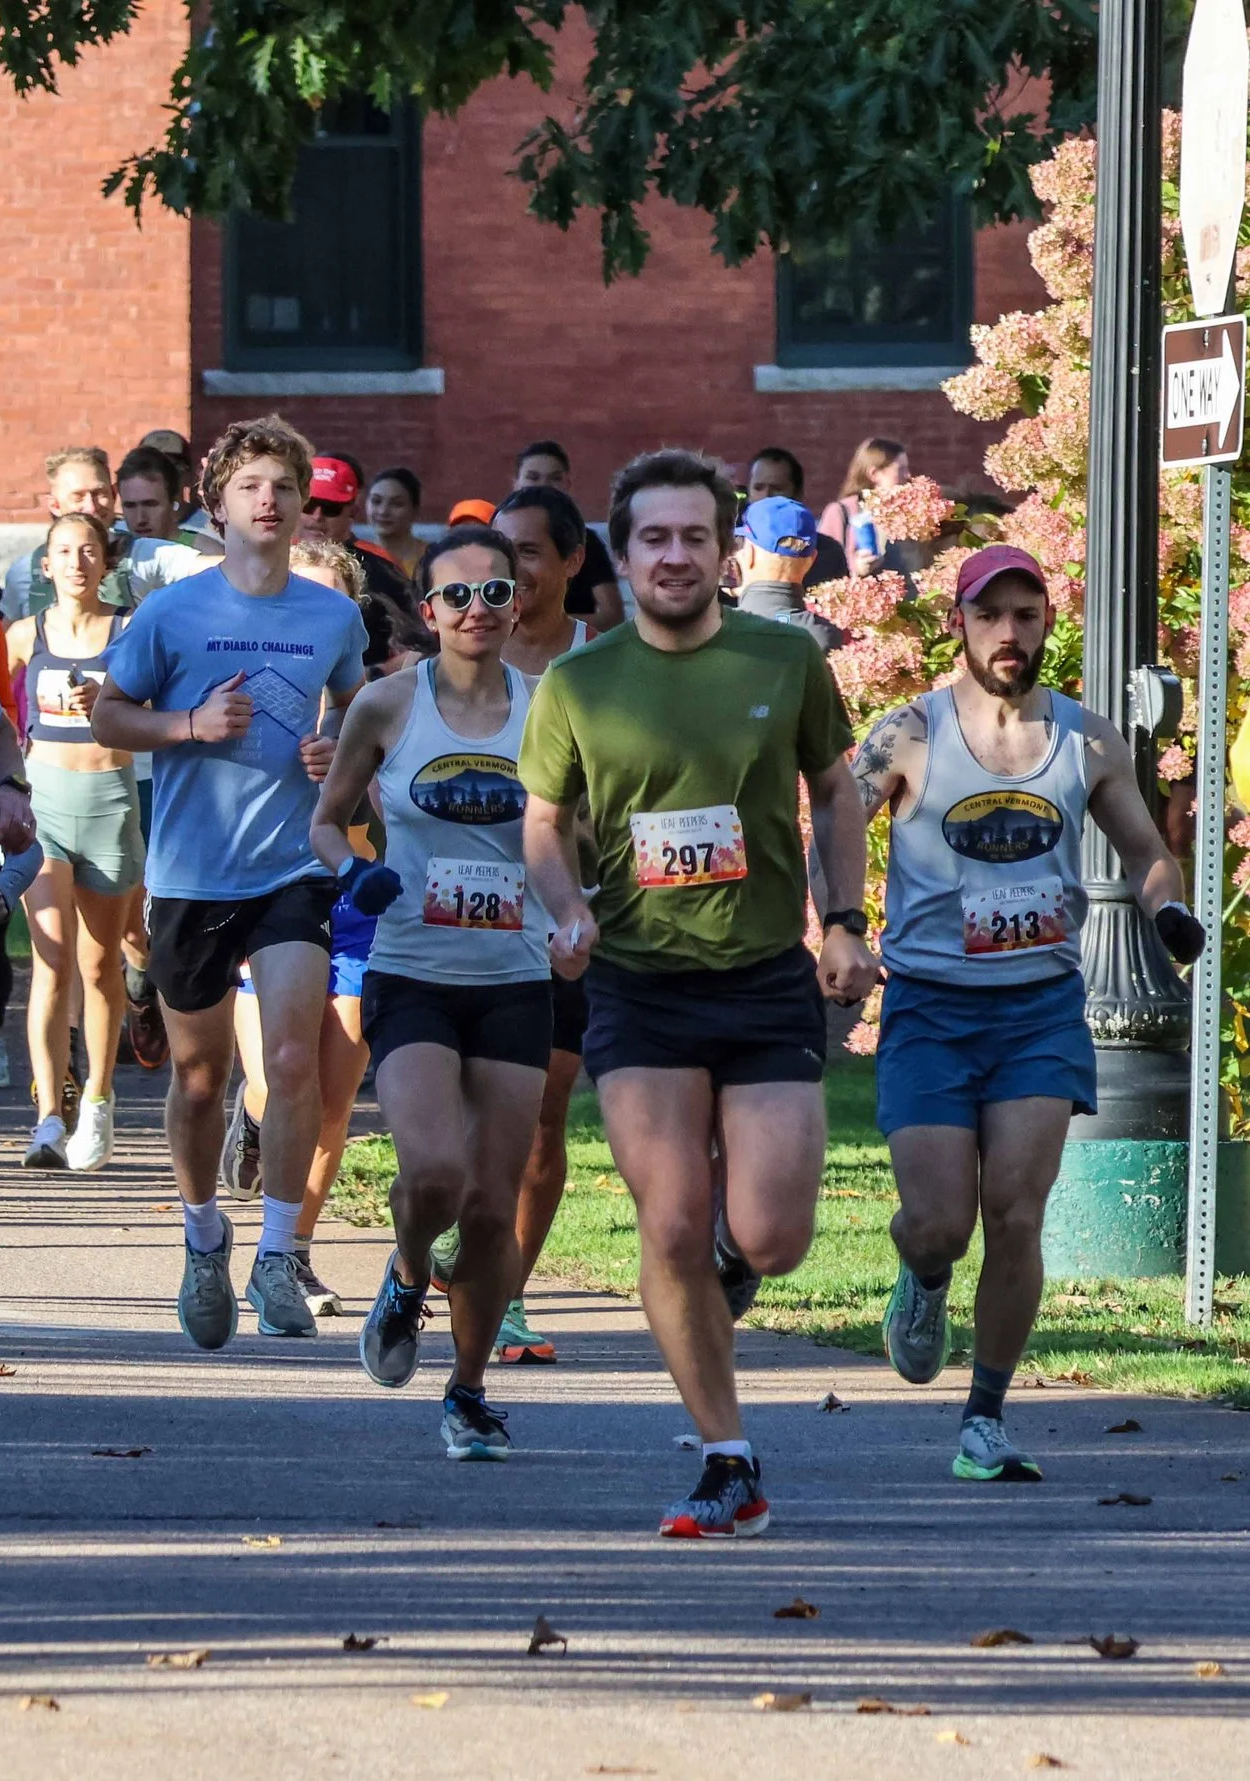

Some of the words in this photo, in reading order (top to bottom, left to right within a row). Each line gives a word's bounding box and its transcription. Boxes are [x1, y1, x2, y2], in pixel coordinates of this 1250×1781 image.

[1172, 369, 1195, 421] ONE
[1200, 366, 1221, 416] WAY
[206, 641, 221, 652] MT
[223, 641, 258, 652] DIABLO
[262, 641, 315, 656] CHALLENGE
[432, 760, 470, 773] CENTRAL
[474, 760, 518, 775] VERMONT
[448, 803, 506, 815] RUNNERS
[964, 797, 1003, 812] CENTRAL
[1005, 796, 1049, 812] VERMONT
[977, 840, 1030, 852] RUNNERS
[662, 842, 715, 876] 297
[458, 865, 473, 876] LEAF
[475, 867, 500, 877] PEEPERS
[1010, 886, 1037, 897] PEEPERS
[453, 892, 501, 921] 128
[991, 911, 1041, 944] 213
